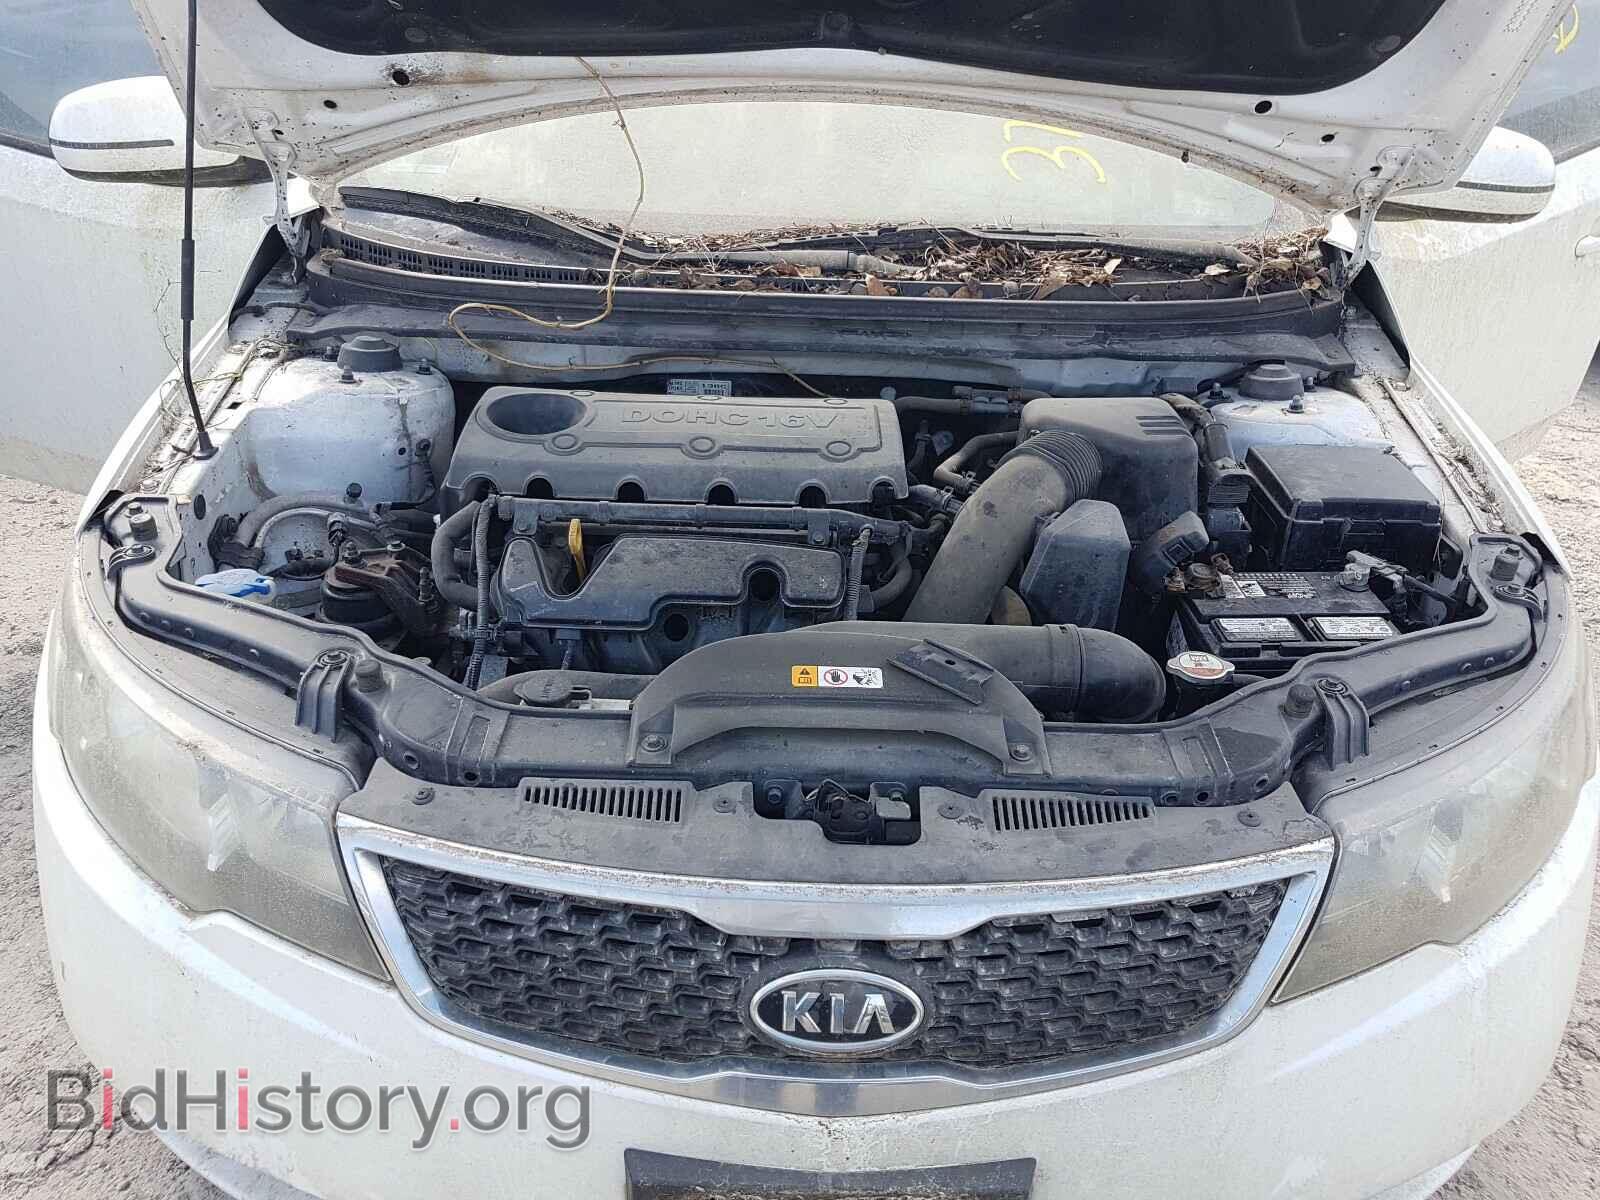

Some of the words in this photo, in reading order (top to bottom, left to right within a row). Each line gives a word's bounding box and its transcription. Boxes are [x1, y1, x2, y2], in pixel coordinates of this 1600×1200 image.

[621, 406, 749, 426] DOHC
[758, 411, 839, 429] 16V
[781, 991, 897, 1034] KIA
